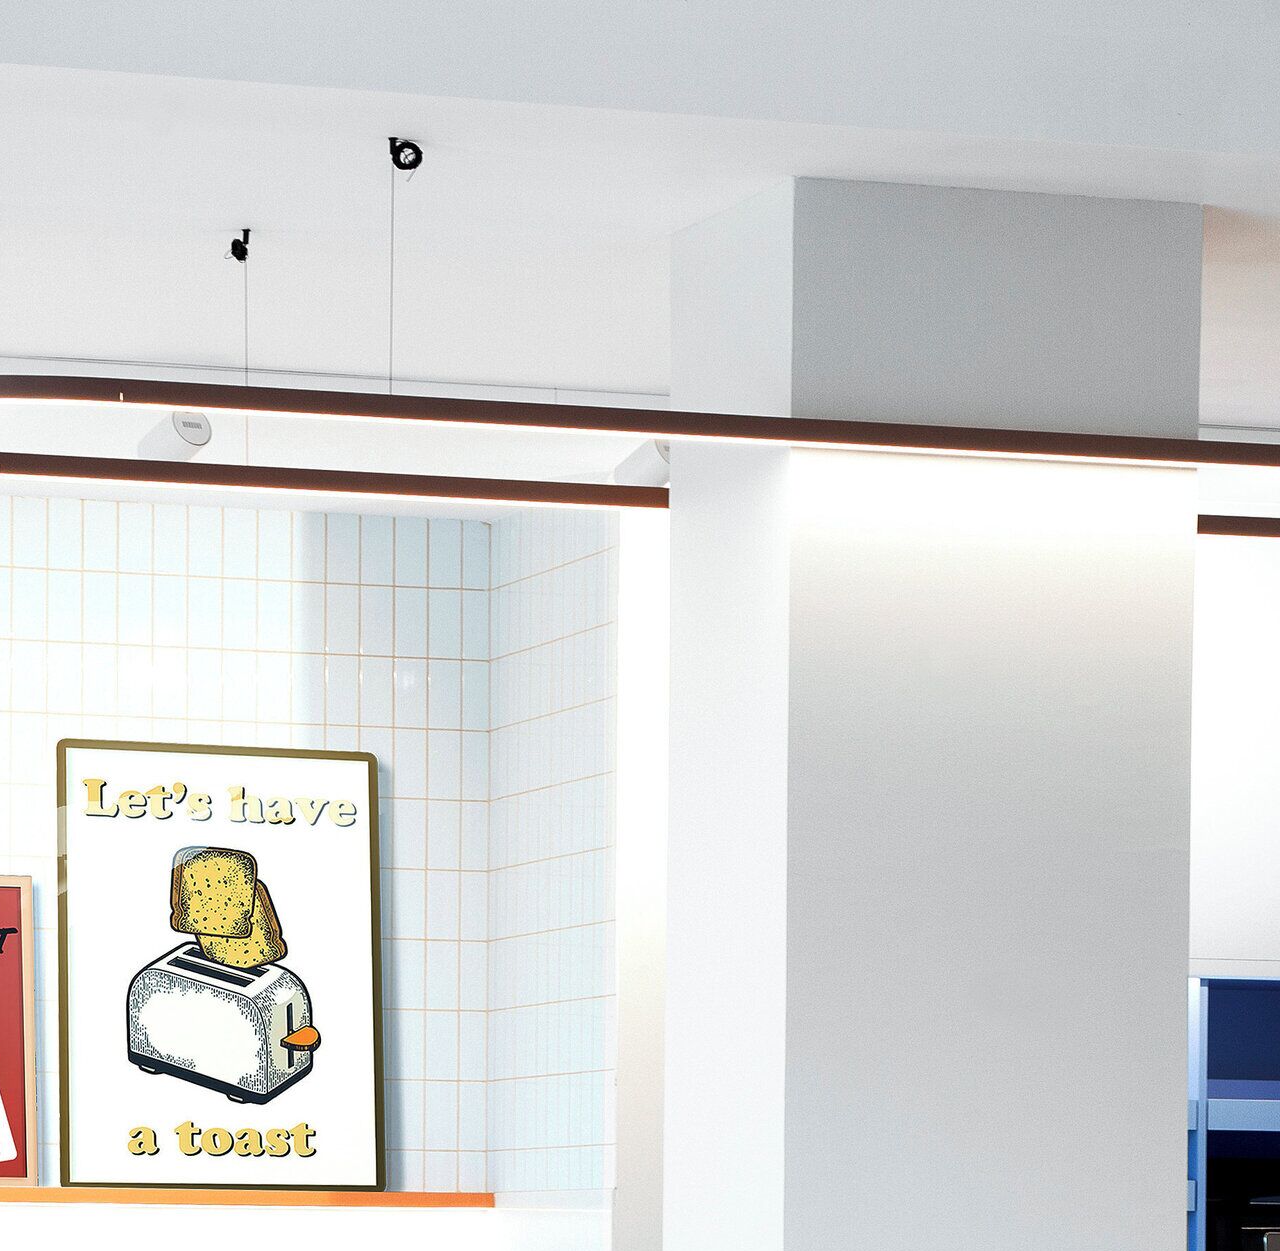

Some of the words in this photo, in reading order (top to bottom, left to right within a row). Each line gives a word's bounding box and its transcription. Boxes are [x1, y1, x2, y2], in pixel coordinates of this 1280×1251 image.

[82, 777, 214, 822] Let's
[227, 785, 358, 827] have
[128, 1125, 161, 1157] a
[173, 1120, 318, 1159] toast
